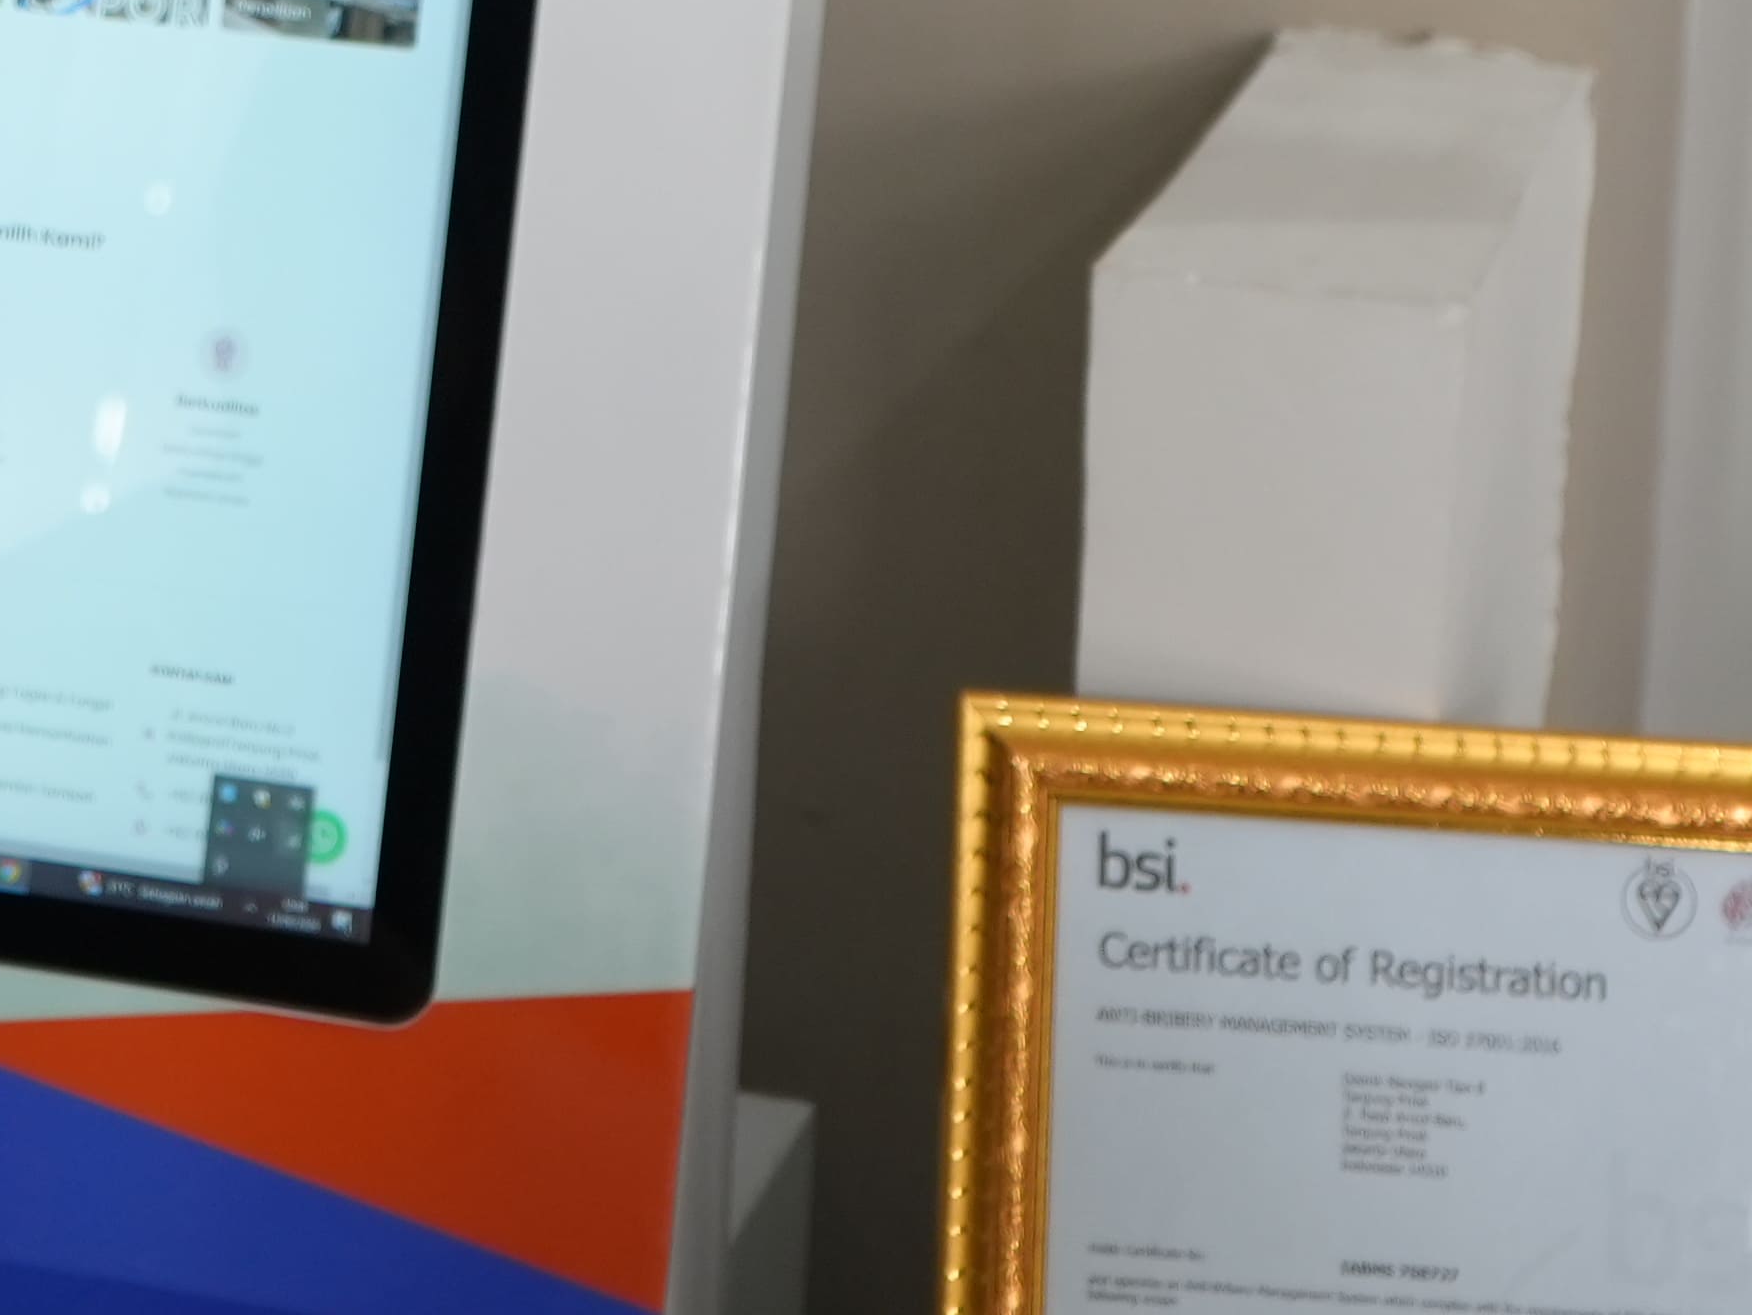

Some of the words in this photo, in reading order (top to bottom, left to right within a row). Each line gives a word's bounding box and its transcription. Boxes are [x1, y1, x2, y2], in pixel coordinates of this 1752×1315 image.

[1099, 931, 1301, 984] Certificate
[1315, 945, 1356, 984] of
[1370, 950, 1607, 1002] Registration
[1343, 1024, 1412, 1044] SYSTEM
